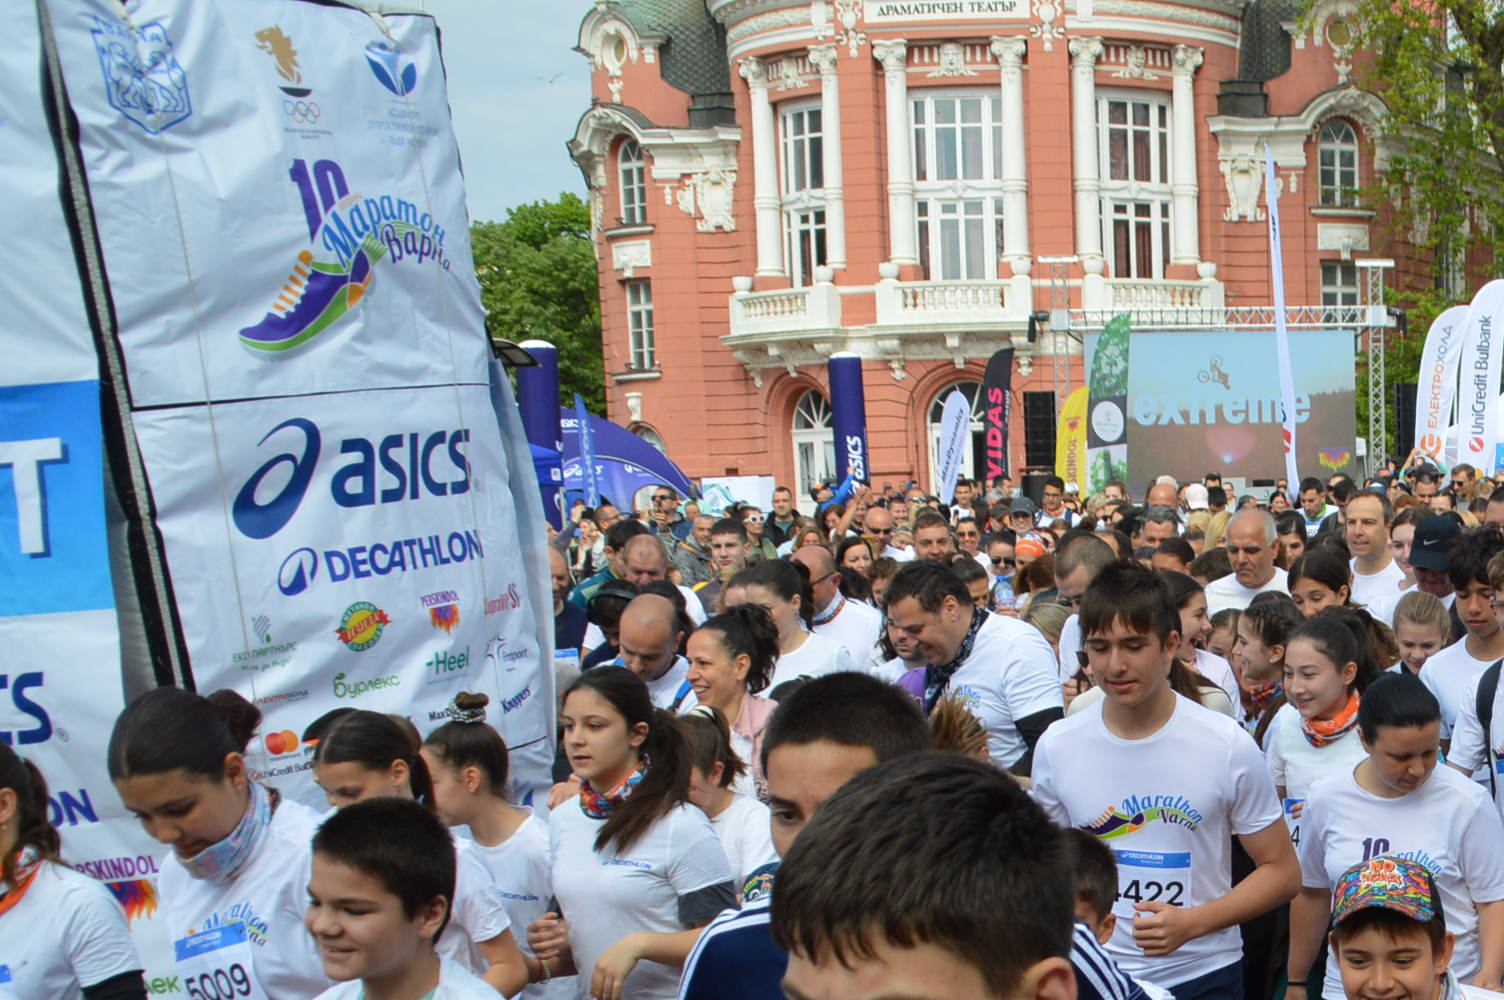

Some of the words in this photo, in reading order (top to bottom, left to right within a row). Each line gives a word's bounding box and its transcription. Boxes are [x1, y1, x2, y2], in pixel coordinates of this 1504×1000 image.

[876, 2, 964, 18] ДРАМАТИЧЕН
[968, 0, 1017, 15] ТЕАТЪР
[1474, 315, 1492, 371] Bulbank
[1471, 373, 1489, 435] UniCredit
[985, 386, 1004, 481] VIDAS
[330, 427, 471, 509] asics
[324, 528, 484, 584] DECATHLON
[1121, 794, 1204, 825] Marathon
[1156, 807, 1197, 832] Varna
[1115, 879, 1185, 907] 422
